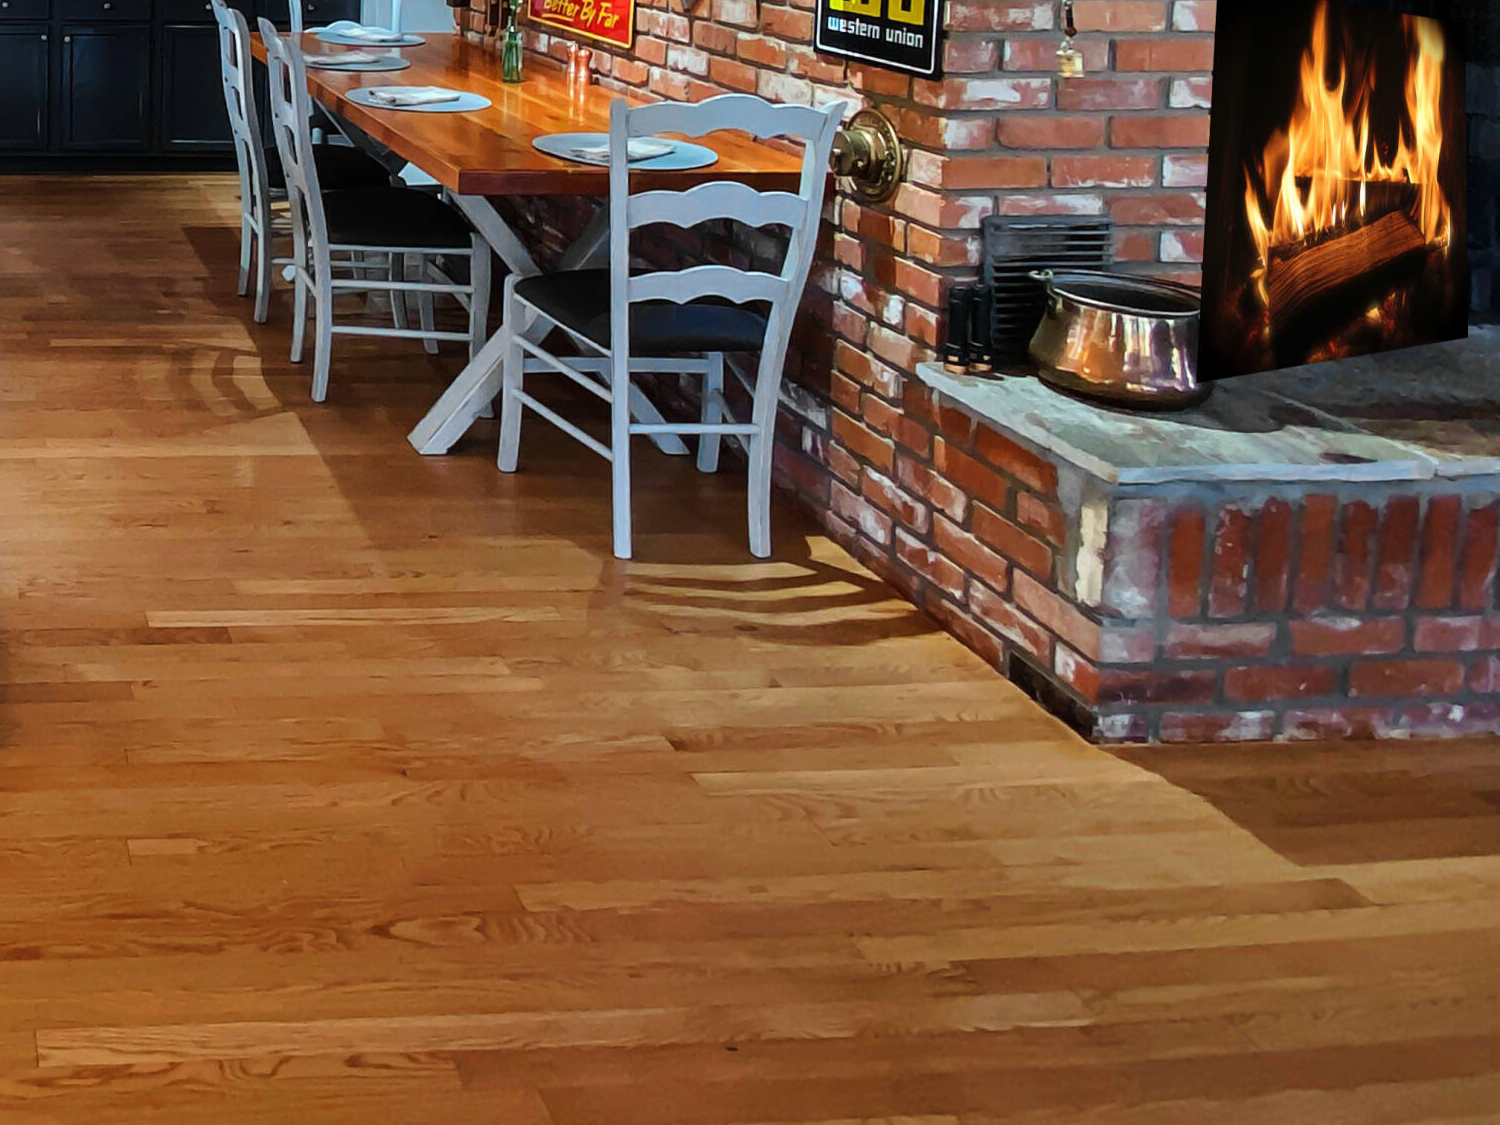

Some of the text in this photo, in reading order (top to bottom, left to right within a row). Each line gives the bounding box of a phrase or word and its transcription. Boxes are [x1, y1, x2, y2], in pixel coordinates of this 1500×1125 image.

[597, 1, 620, 28] Far
[827, 16, 924, 49] western union
